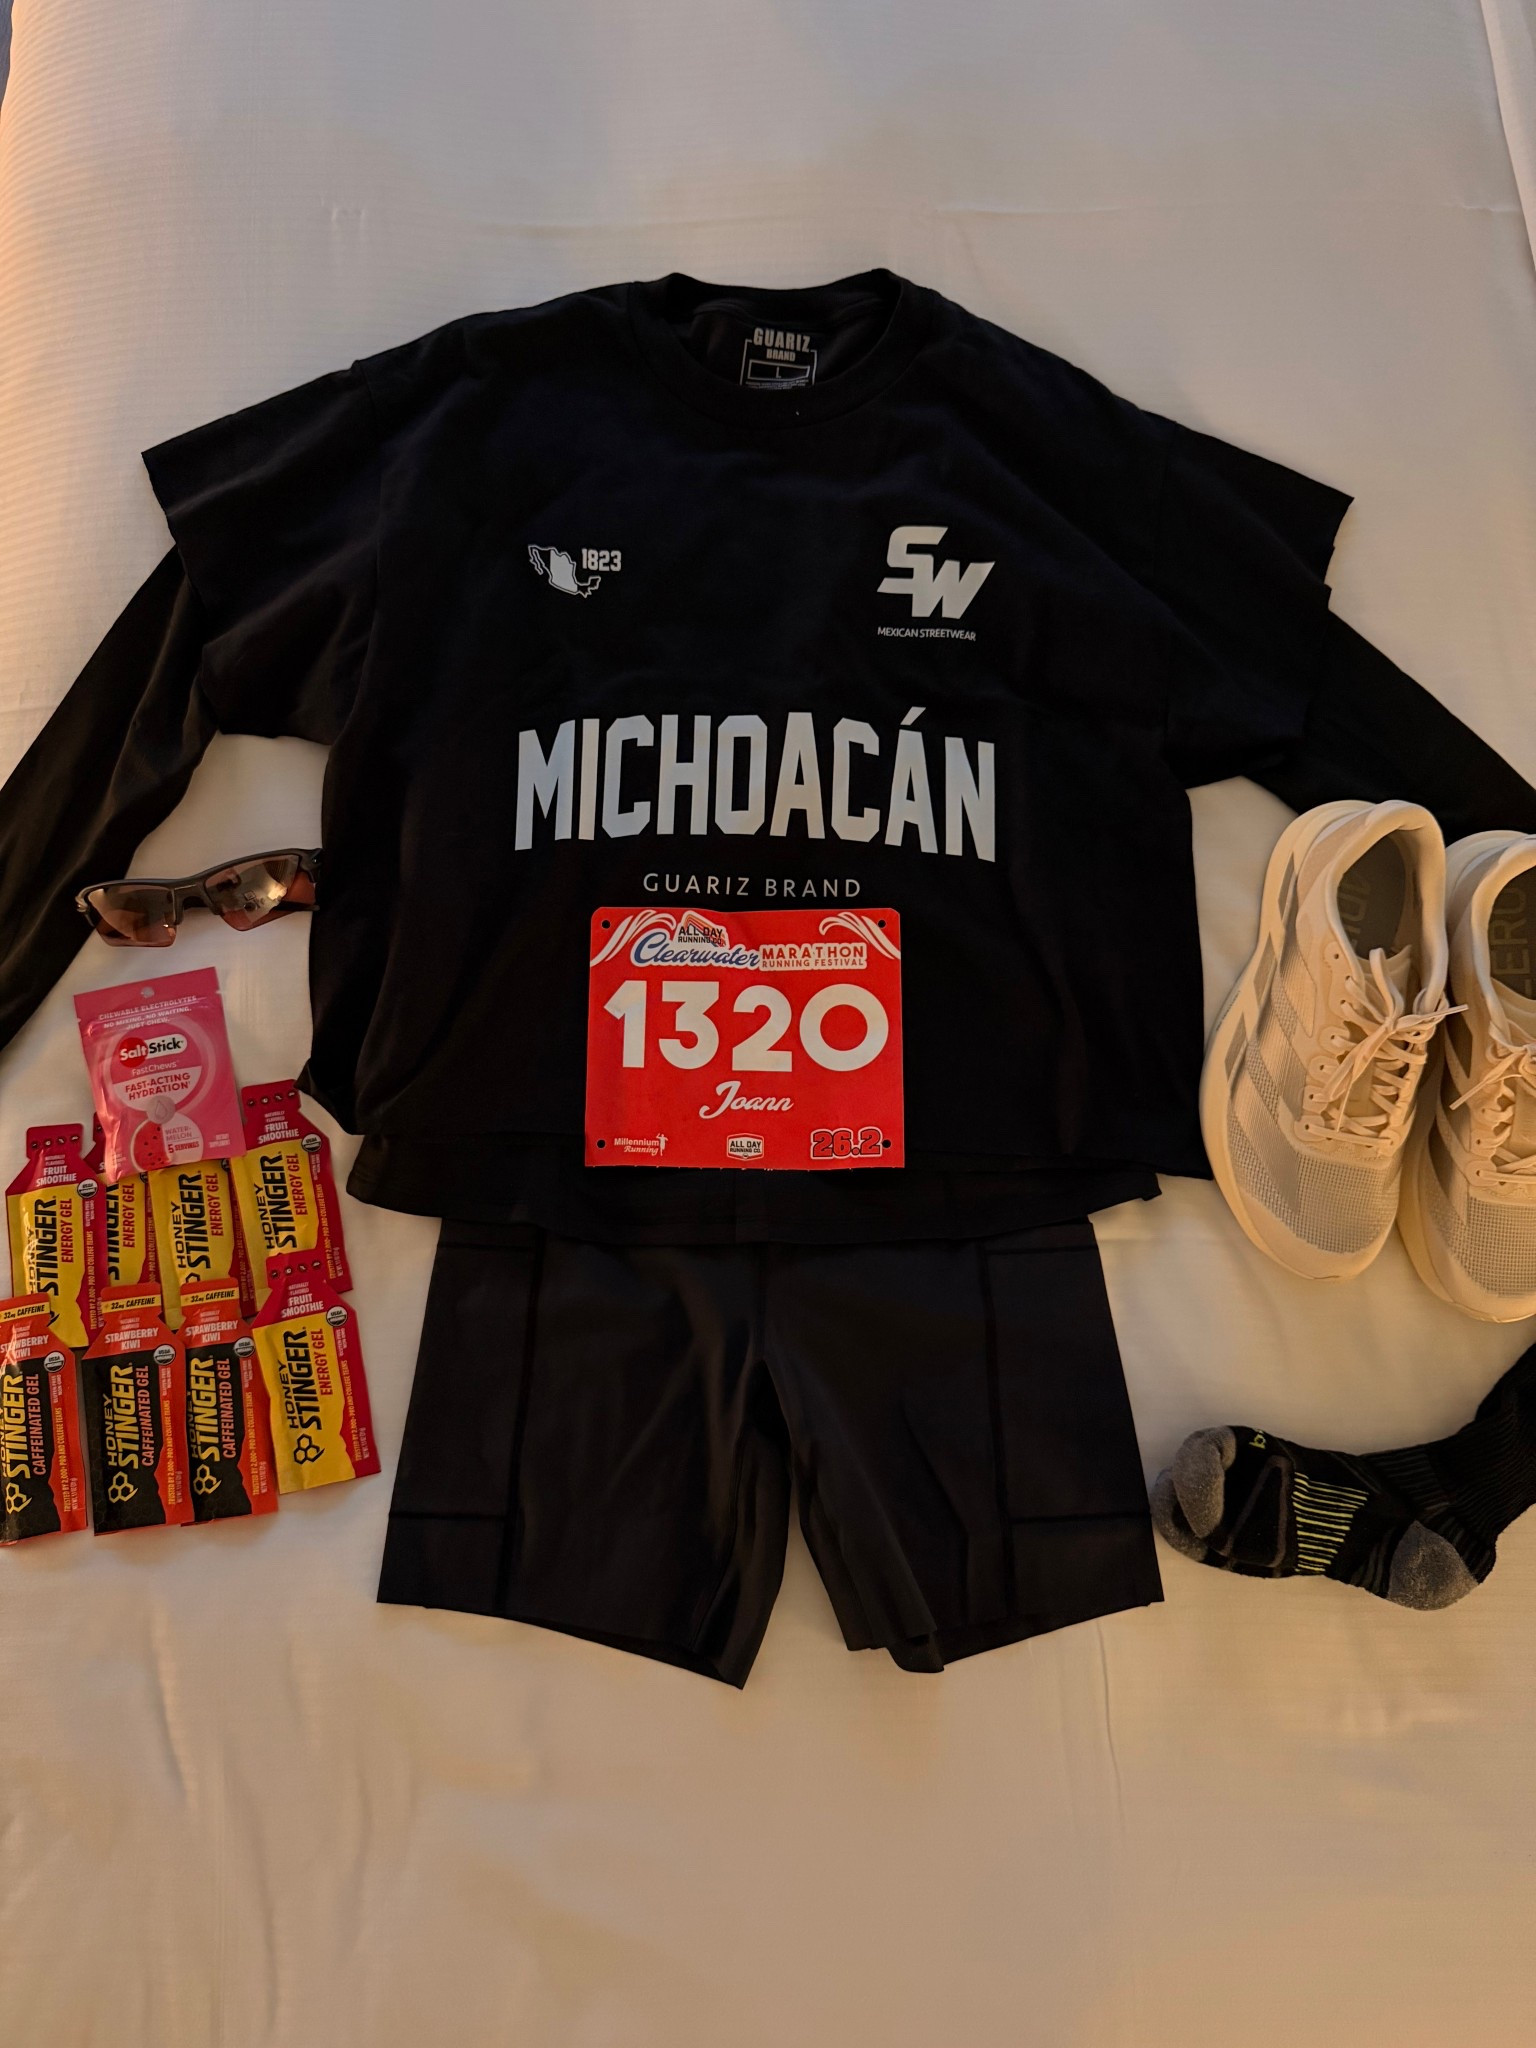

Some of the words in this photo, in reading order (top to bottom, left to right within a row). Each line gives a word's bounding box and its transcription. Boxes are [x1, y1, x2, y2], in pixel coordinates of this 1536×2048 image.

[753, 327, 811, 352] GUARIZ
[766, 348, 796, 361] BRAND
[776, 366, 781, 378] L
[581, 547, 622, 572] 1823
[877, 626, 919, 638] MEXICAN
[919, 628, 977, 642] STREETWEAR
[515, 706, 996, 863] MICHOACÁN
[643, 872, 750, 896] GUARIZ
[765, 878, 861, 898] BRAND
[678, 926, 698, 937] ALL
[702, 926, 723, 939] DAY
[678, 936, 711, 944] RUNNING
[634, 931, 761, 966] Clearwater
[762, 945, 864, 960] MARATHON
[762, 959, 810, 968] RUNNING
[814, 959, 864, 968] FESTIVAL
[99, 1006, 140, 1020] CHEWABLE
[141, 995, 197, 1011] ELECTROLYTES
[603, 980, 889, 1072] 1320
[132, 1061, 177, 1076] FastChews
[125, 1072, 191, 1093] FAST-ACTING
[699, 1081, 794, 1119] Joann
[258, 1128, 300, 1145] SMOOTHIE
[265, 1121, 289, 1133] FRUIT
[167, 1143, 174, 1153] 5
[174, 1141, 200, 1151] SERVINGS
[614, 1136, 660, 1147] Millennium
[623, 1145, 659, 1156] Running
[730, 1140, 745, 1148] ALL
[746, 1140, 762, 1149] DAY
[812, 1129, 881, 1158] 26.2
[43, 1165, 68, 1176] FRUIT
[286, 1153, 300, 1173] GEL
[36, 1173, 77, 1187] SMOOTHIE
[205, 1172, 219, 1192] GEL
[123, 1183, 135, 1203] GEL
[260, 1154, 297, 1249] STINGER
[289, 1174, 308, 1216] ENERGY
[60, 1198, 73, 1218] GEL
[206, 1194, 224, 1237] ENERGY
[254, 1183, 276, 1249] HONEY
[122, 1206, 136, 1249] ENERGY
[178, 1173, 211, 1269] STINGER
[60, 1220, 74, 1263] ENERGY
[171, 1201, 186, 1268] HONEY
[34, 1198, 59, 1296] STINGER
[126, 1297, 156, 1307] CAFFEINE
[206, 1290, 235, 1300] CAFFEINE
[288, 1293, 313, 1307] FRUIT
[17, 1304, 45, 1316] CAFFEINE
[281, 1300, 324, 1319] SMOOTHIE
[104, 1327, 159, 1344] STRAWBERRY
[185, 1320, 239, 1337] STRAWBERRY
[202, 1332, 221, 1344] KIWI
[311, 1328, 326, 1349] GEL
[121, 1339, 141, 1351] KIWI
[135, 1365, 149, 1387] GEL
[217, 1358, 231, 1379] GEL
[313, 1351, 333, 1396] ENERGY
[26, 1373, 39, 1396] GEL
[283, 1330, 322, 1431] STINGER
[278, 1359, 300, 1429] HONEY
[110, 1364, 140, 1470] STINGER
[190, 1357, 220, 1462] STINGER
[219, 1381, 236, 1459] CAFFEINATED
[3, 1374, 31, 1479] STINGER
[56, 1424, 65, 1444] COLLEGE
[102, 1393, 118, 1467] HONEY
[137, 1391, 155, 1467] CAFFEINATED
[26, 1399, 47, 1476] CAFFEINATED
